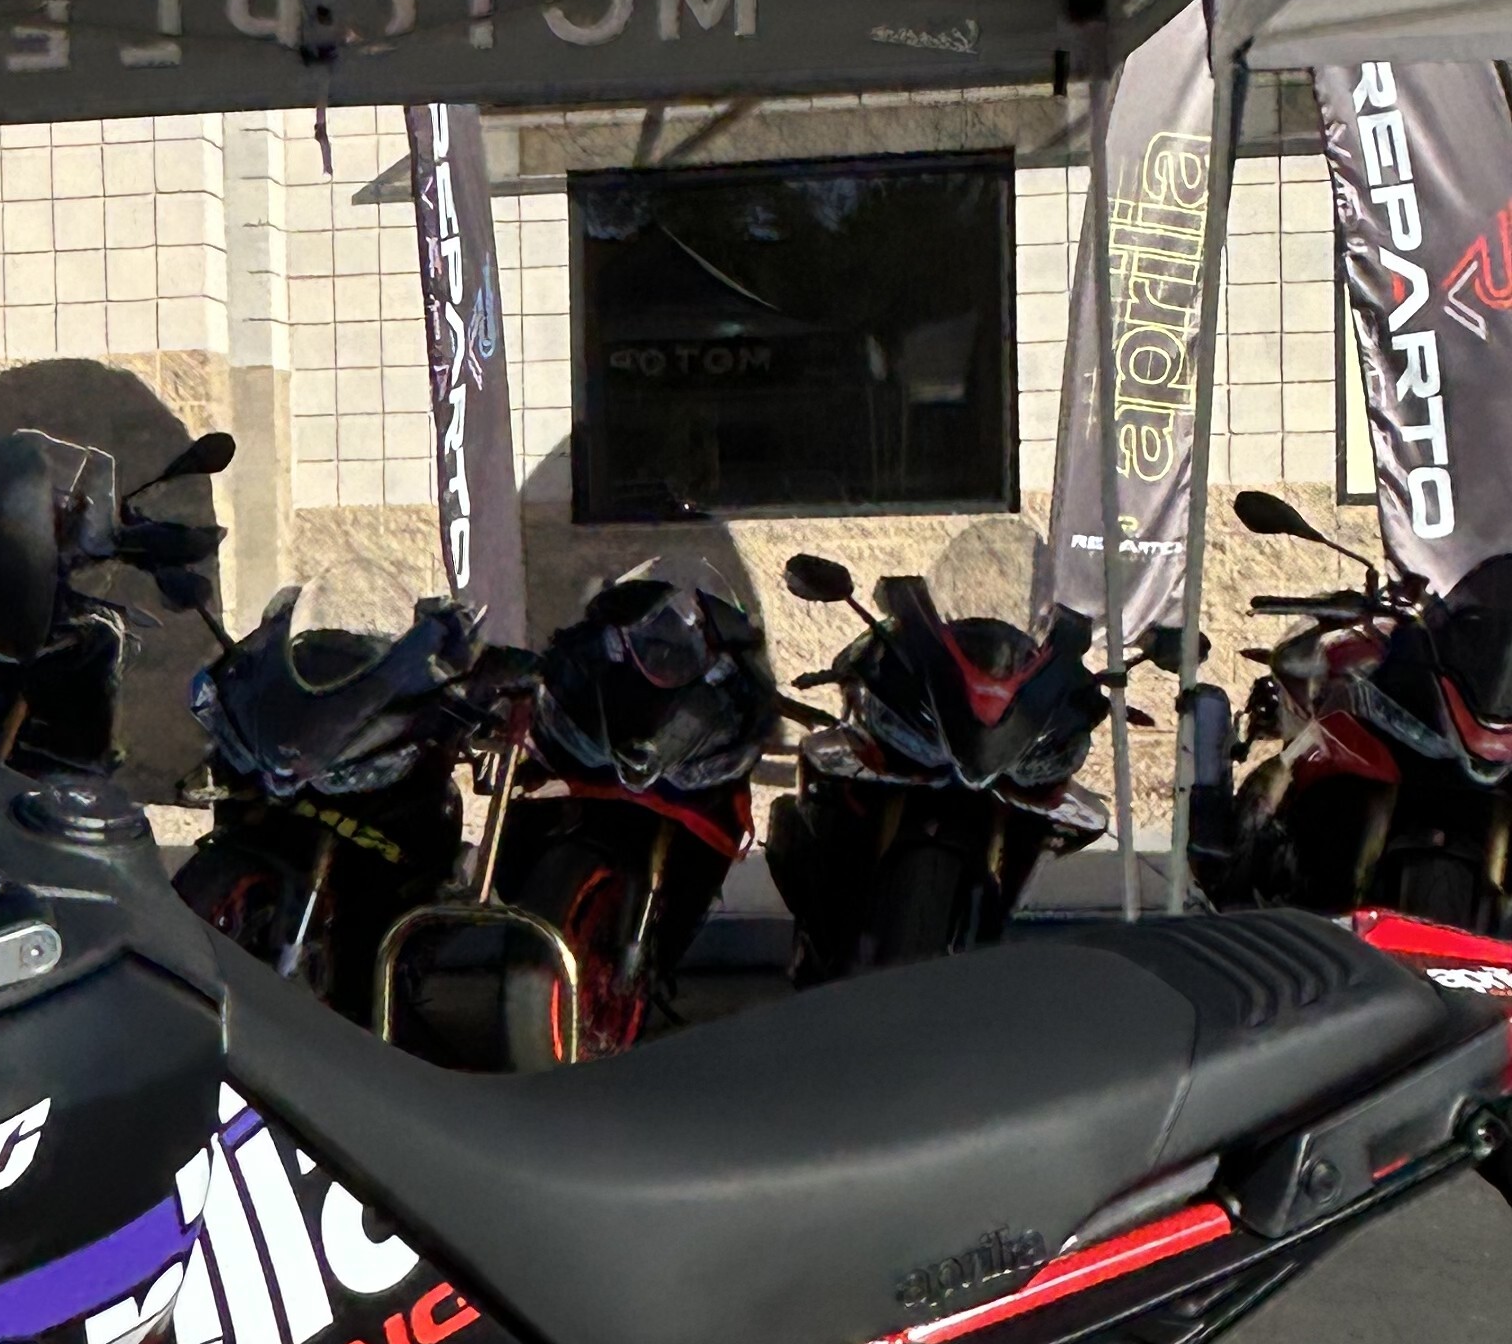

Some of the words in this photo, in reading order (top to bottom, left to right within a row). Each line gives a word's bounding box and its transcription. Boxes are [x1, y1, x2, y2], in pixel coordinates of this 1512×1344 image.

[1108, 131, 1211, 482] aprilia
[1353, 60, 1455, 540] REPARTO
[1071, 534, 1185, 555] REARTO
